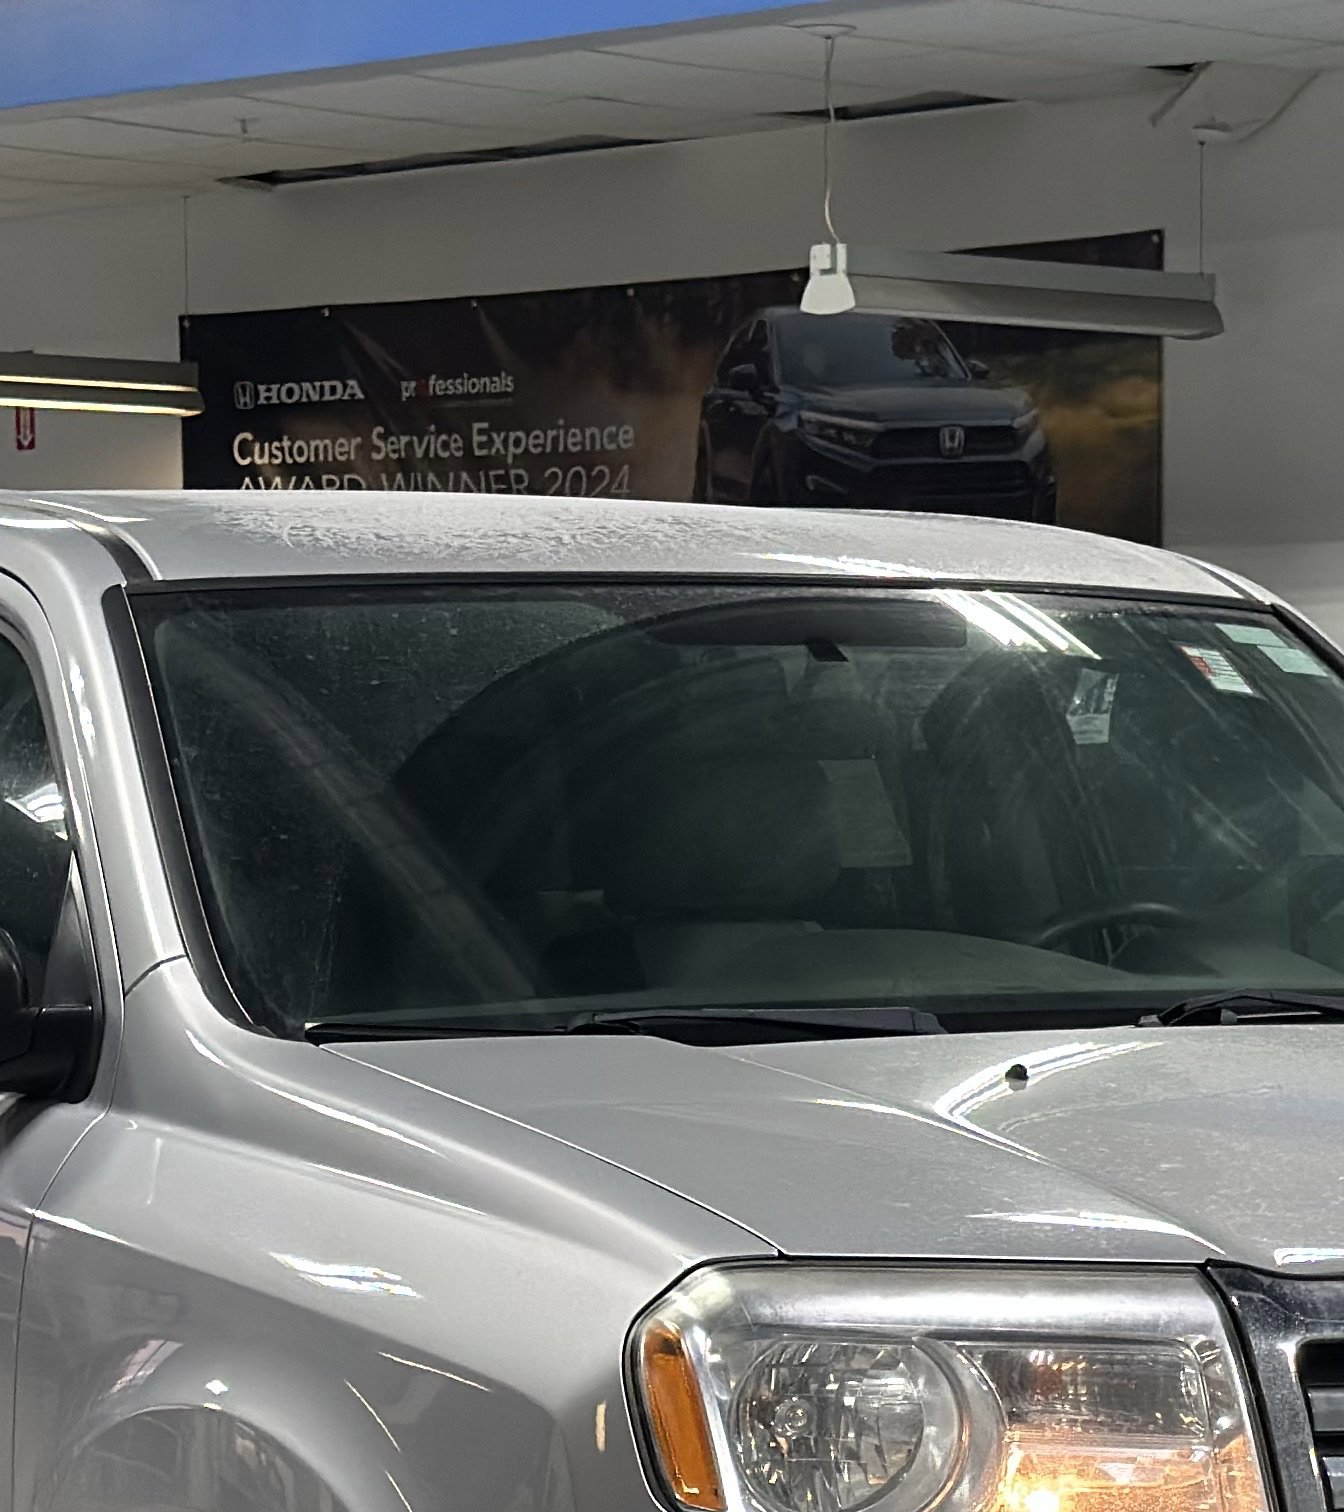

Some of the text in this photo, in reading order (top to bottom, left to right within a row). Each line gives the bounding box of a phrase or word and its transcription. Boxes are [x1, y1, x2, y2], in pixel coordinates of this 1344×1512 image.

[257, 379, 365, 405] HONDA
[233, 418, 635, 465] Customer Service Experience
[544, 464, 631, 499] 2024
